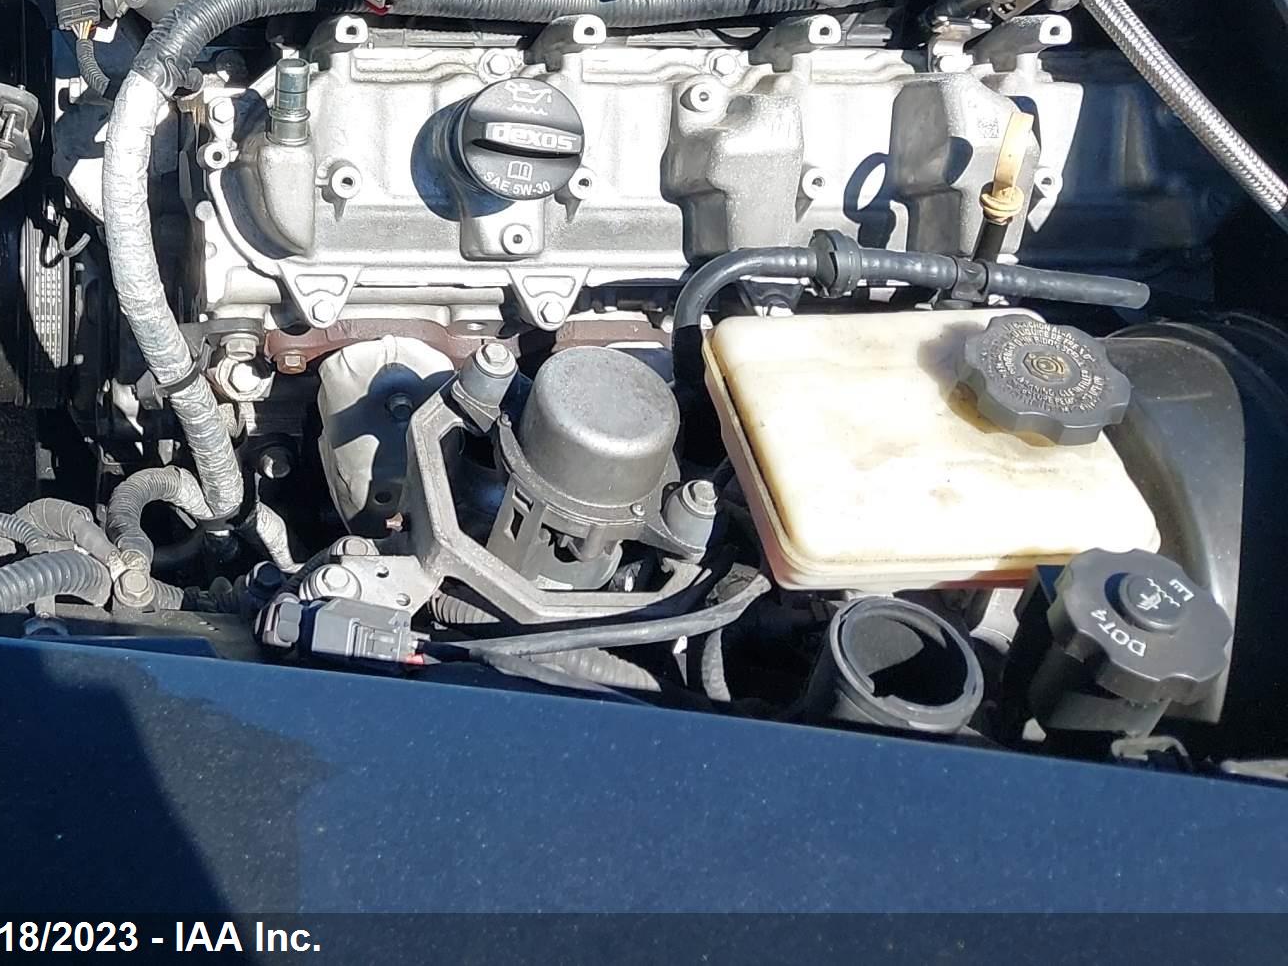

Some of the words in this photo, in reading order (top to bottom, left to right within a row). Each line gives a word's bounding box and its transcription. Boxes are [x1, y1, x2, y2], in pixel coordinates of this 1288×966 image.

[492, 124, 577, 150] dexos
[483, 171, 510, 194] SAE
[512, 179, 551, 196] 5W-30
